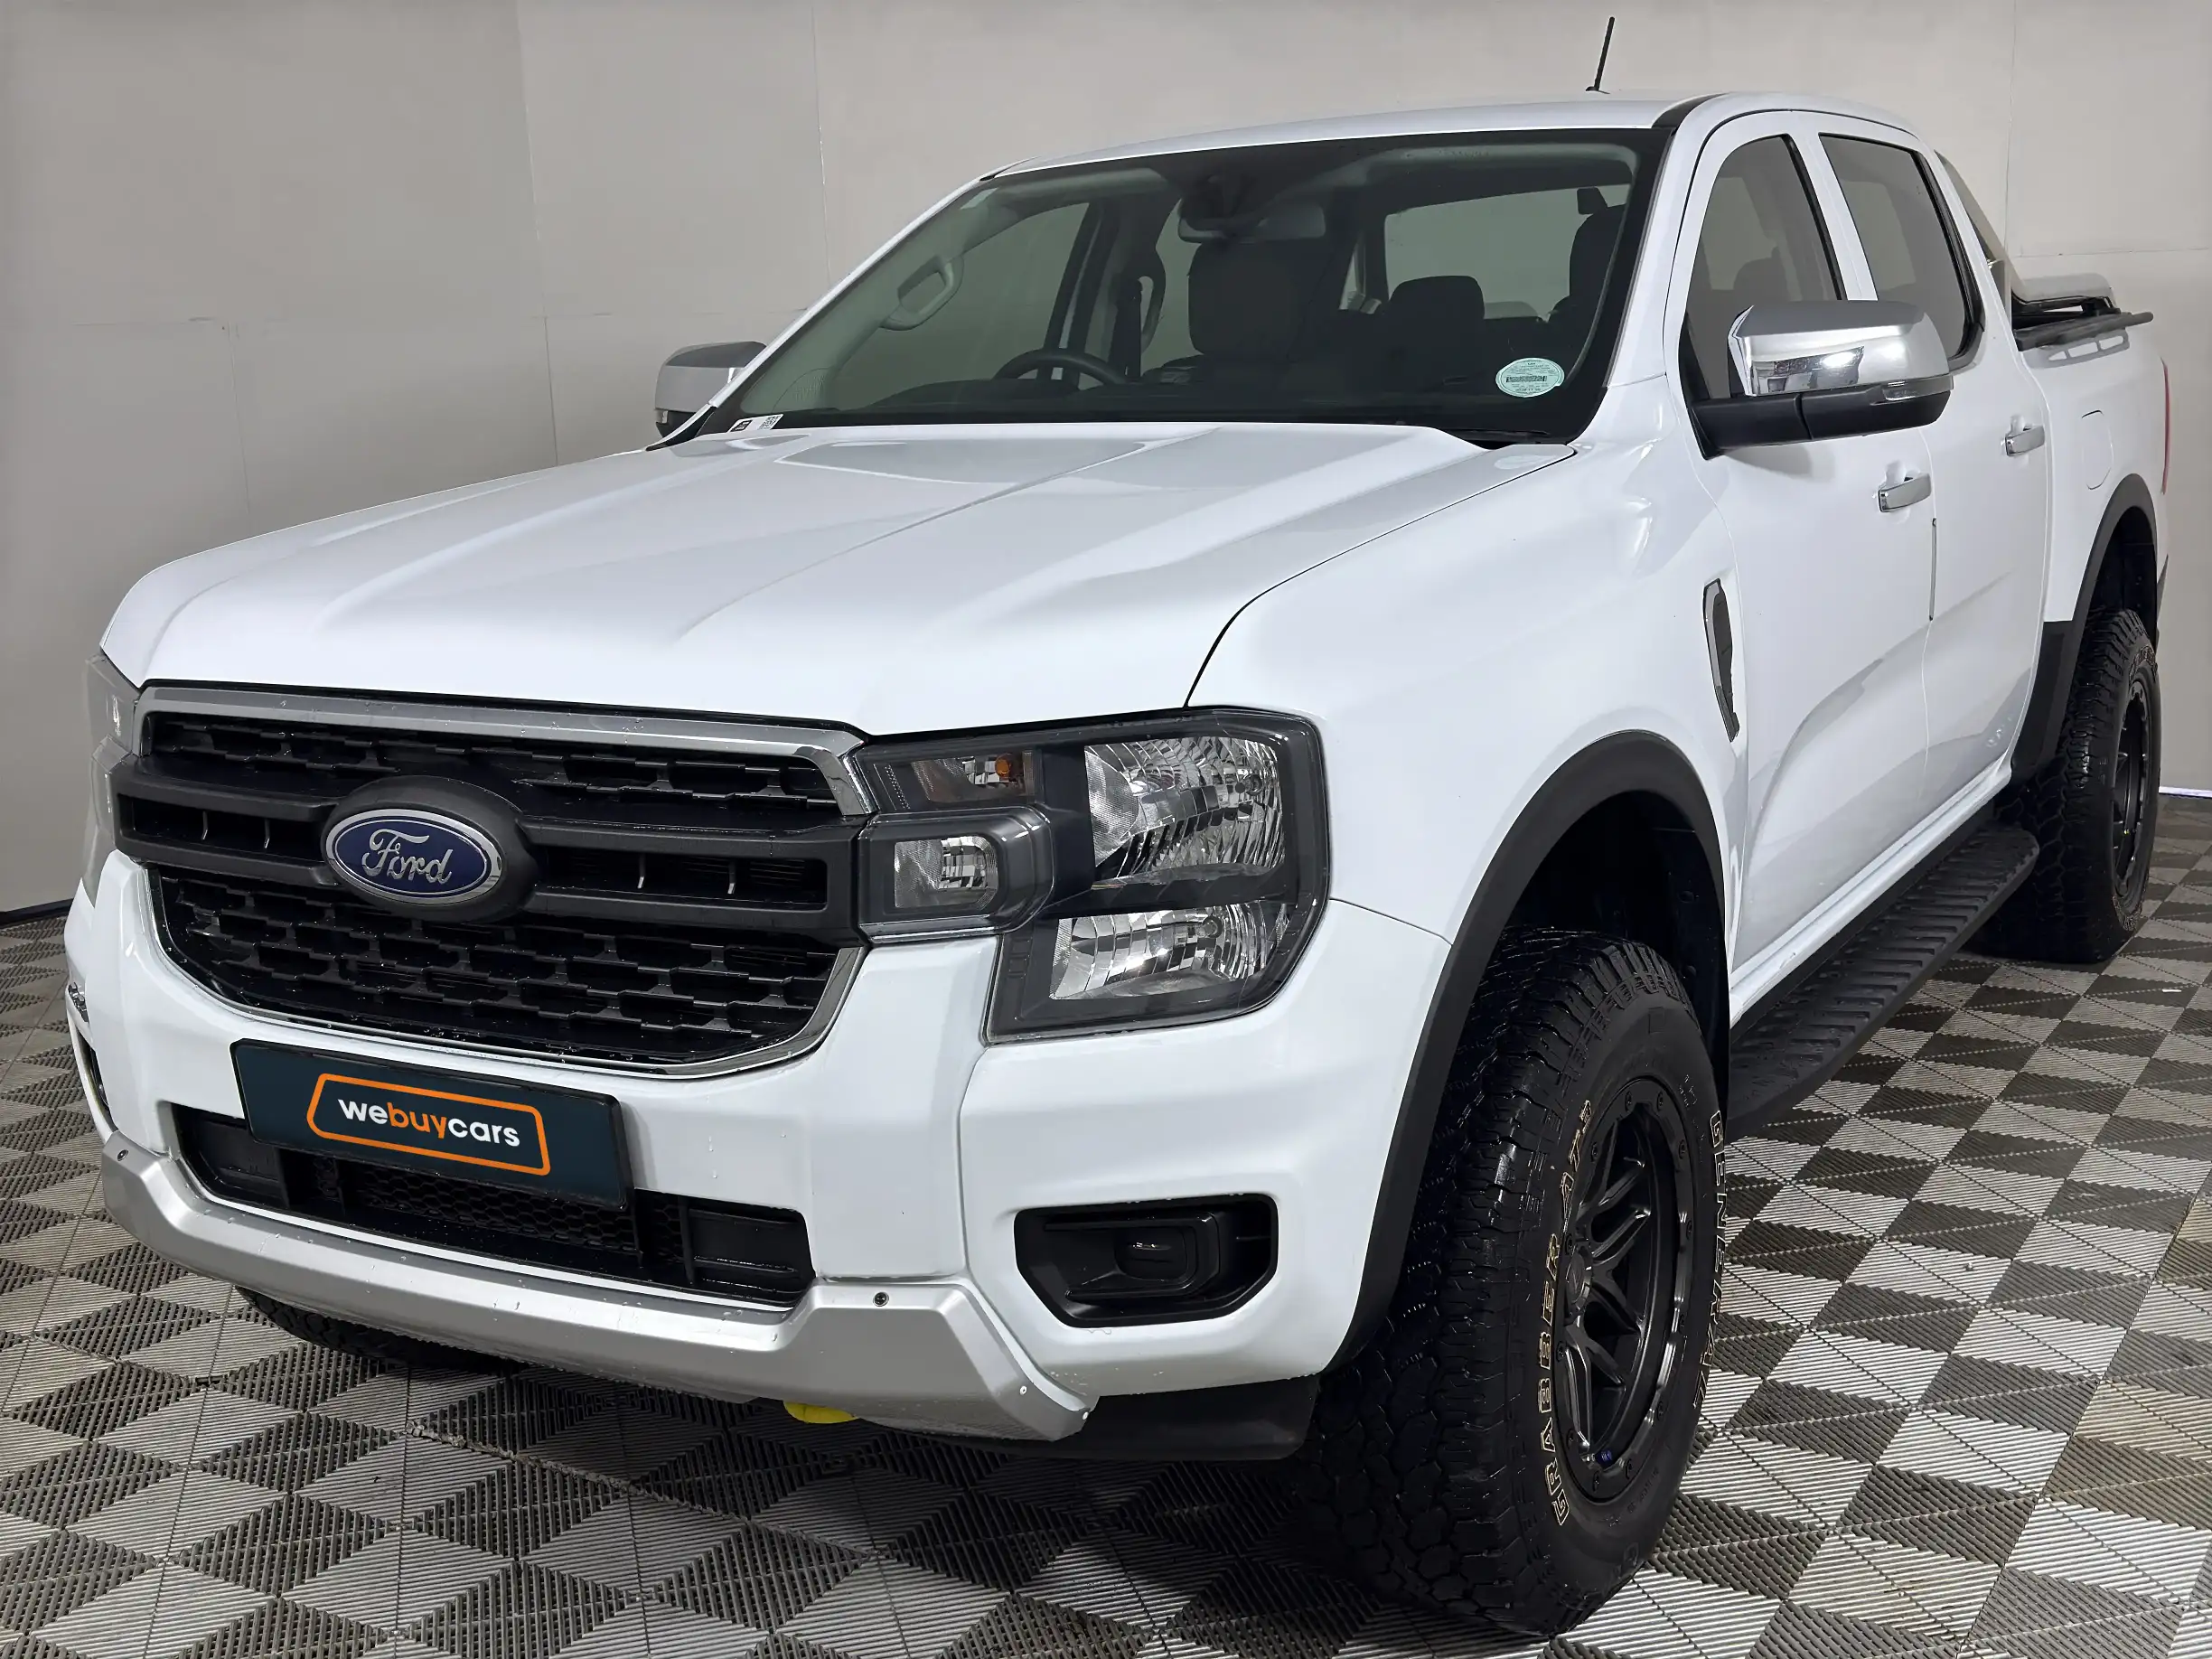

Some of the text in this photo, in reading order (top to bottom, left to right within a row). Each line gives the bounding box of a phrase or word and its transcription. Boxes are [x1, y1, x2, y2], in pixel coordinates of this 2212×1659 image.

[361, 828, 453, 885] Ford
[338, 1098, 520, 1148] webuycars
[1692, 1110, 1728, 1410] GENERAL
[1537, 1233, 1570, 1526] GRABBER
